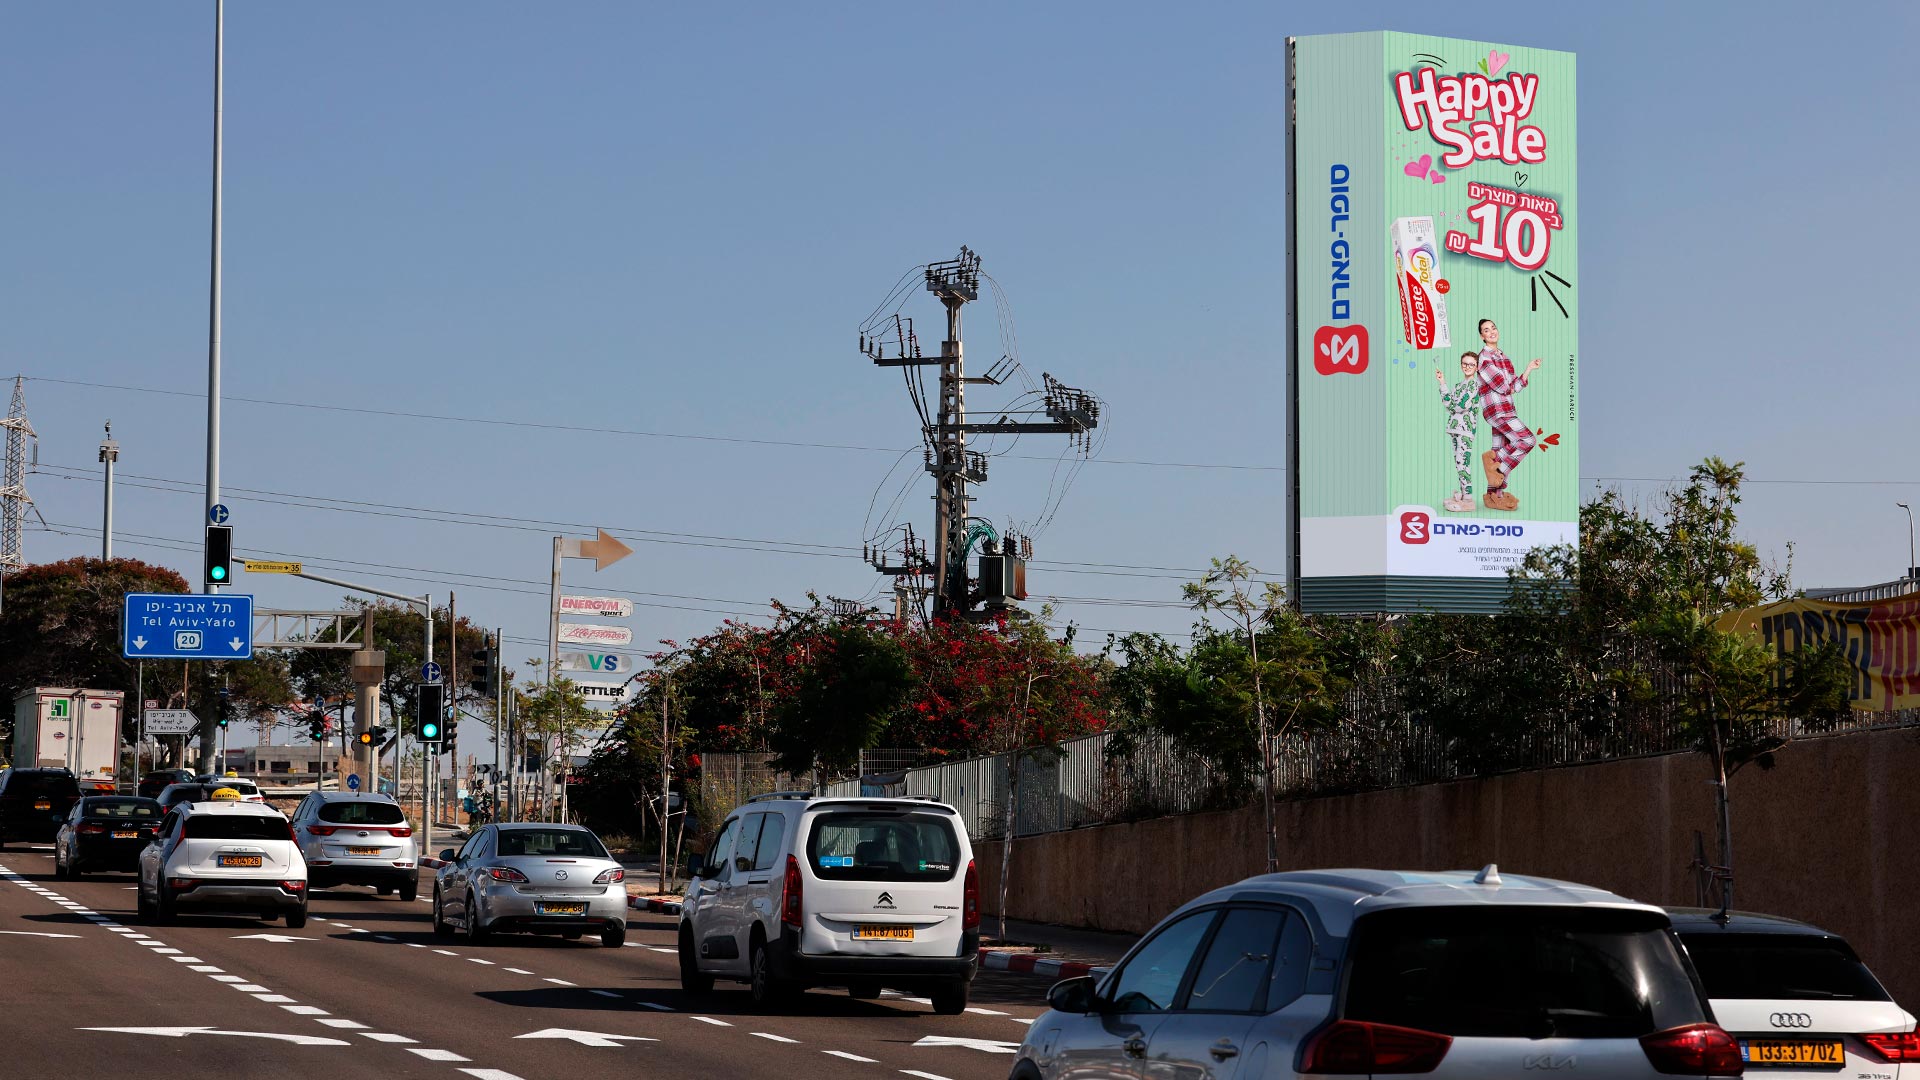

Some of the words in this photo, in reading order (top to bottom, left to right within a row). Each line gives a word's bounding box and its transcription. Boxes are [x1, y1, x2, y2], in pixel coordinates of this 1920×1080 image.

[1395, 67, 1539, 130] Happy
[1431, 110, 1547, 168] Sale
[1469, 184, 1517, 206] מוצרים
[1519, 195, 1555, 214] מאות
[1469, 202, 1549, 268] 10
[1416, 255, 1430, 284] Total
[1412, 285, 1429, 346] Colgate
[1433, 523, 1524, 537] סופר-פארם
[290, 564, 300, 572] 35
[146, 602, 206, 614] אביב-יפו
[212, 601, 232, 614] תל
[561, 598, 619, 611] ENERGYM
[142, 616, 162, 627] Tel
[169, 617, 236, 628] Aviv-Yafo
[181, 635, 196, 645] 20
[575, 685, 625, 697] KETTLER
